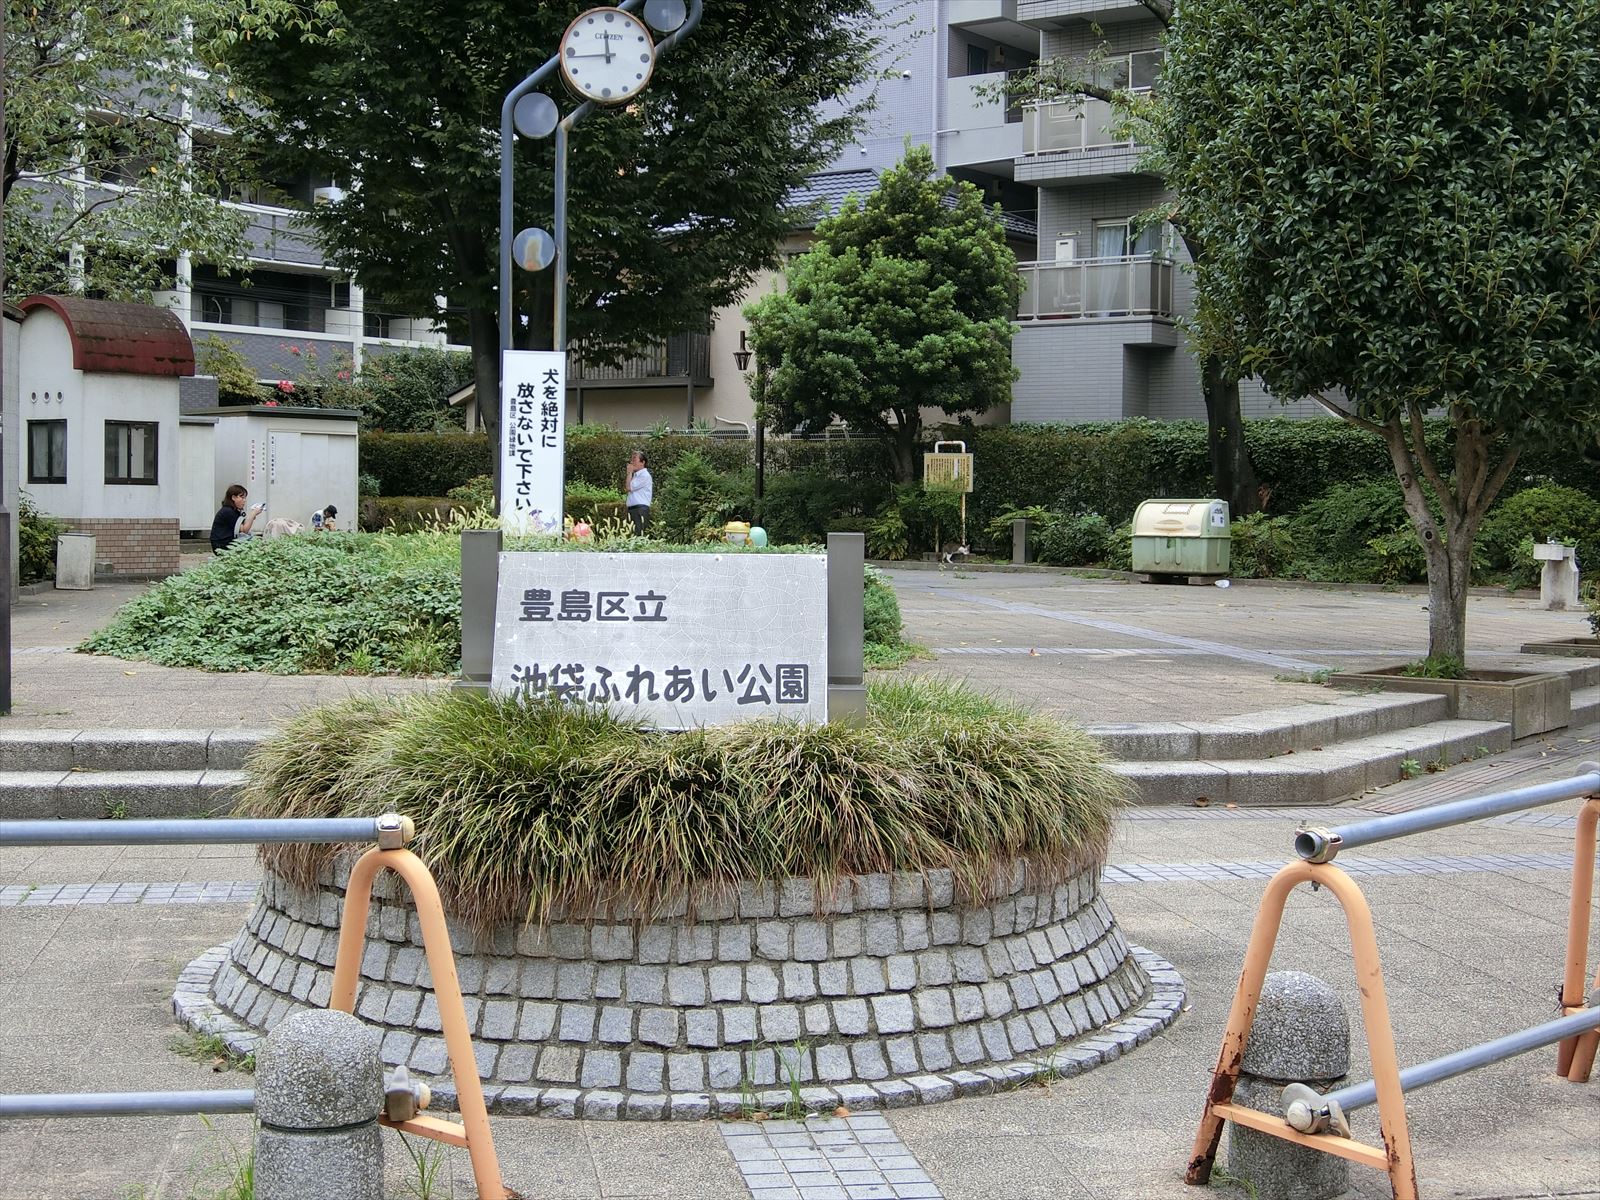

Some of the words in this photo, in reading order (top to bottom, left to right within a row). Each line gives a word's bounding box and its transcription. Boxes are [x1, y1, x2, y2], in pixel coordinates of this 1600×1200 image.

[541, 369, 559, 448] 犬を絶対に
[516, 382, 534, 510] 放さないで下さい
[519, 588, 668, 622] 豊島区立
[511, 663, 809, 705] 池袋ふれあい公園
